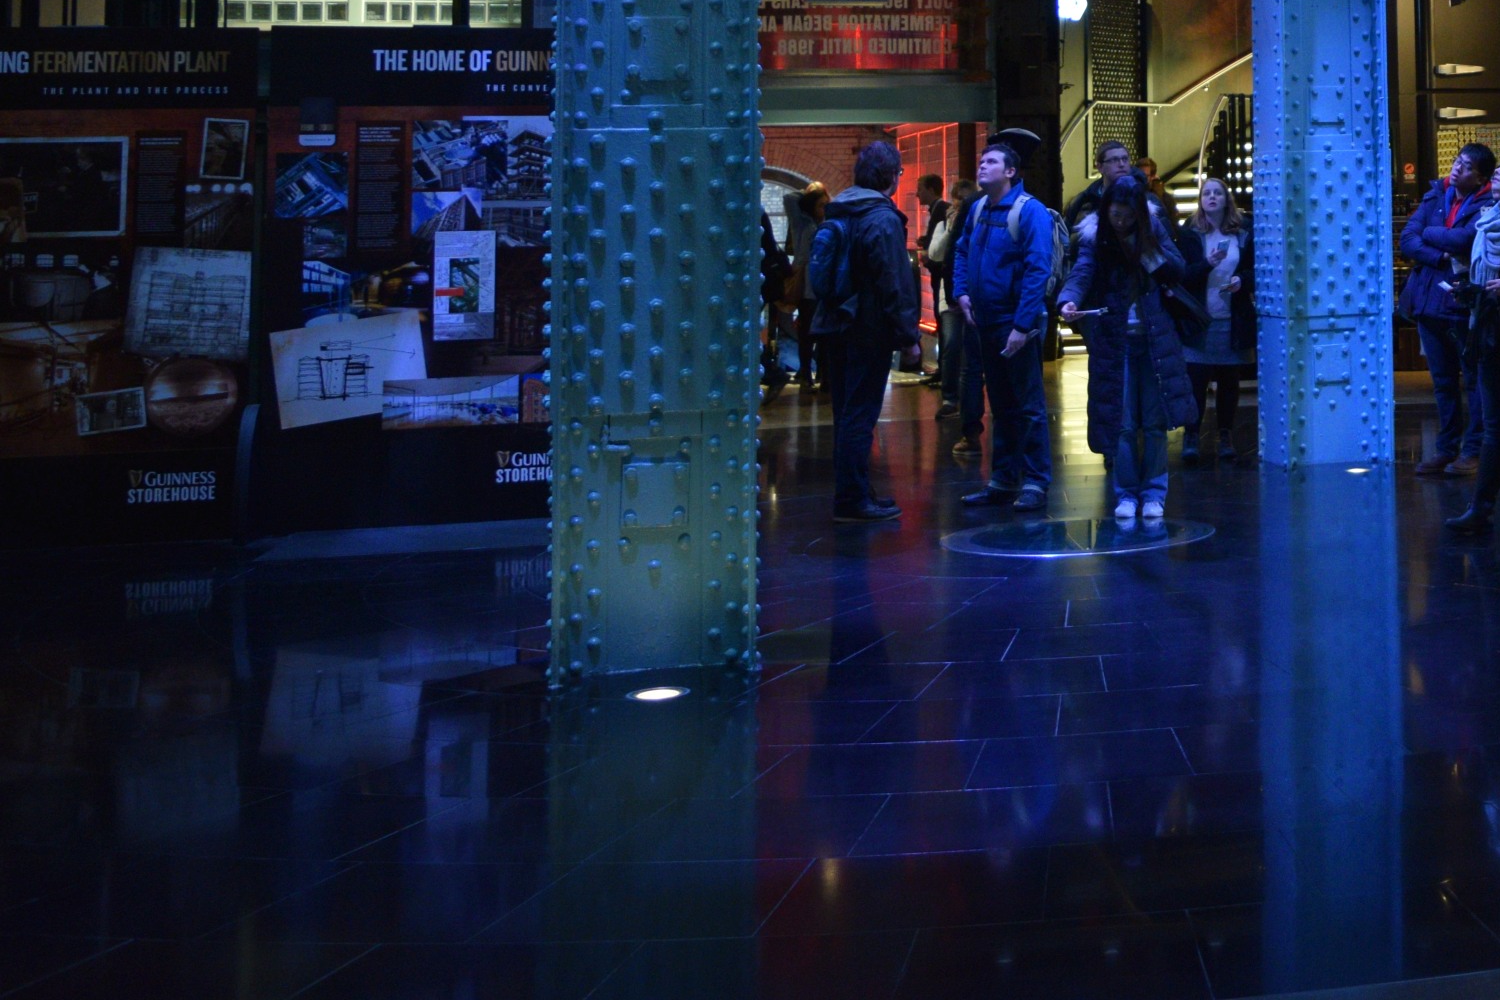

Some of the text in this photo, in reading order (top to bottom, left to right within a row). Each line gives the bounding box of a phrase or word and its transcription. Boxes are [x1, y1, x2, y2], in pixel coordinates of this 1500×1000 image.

[0, 50, 231, 74] ING FERMENTATION PLANT
[373, 49, 551, 72] THE HOME OF GUINN
[43, 85, 229, 96] THE PLANT AND THE PROCESS
[512, 83, 549, 92] CONVE
[511, 451, 551, 467] GUIN
[144, 469, 217, 488] GUINNESS
[127, 485, 217, 505] STOREHOUSE
